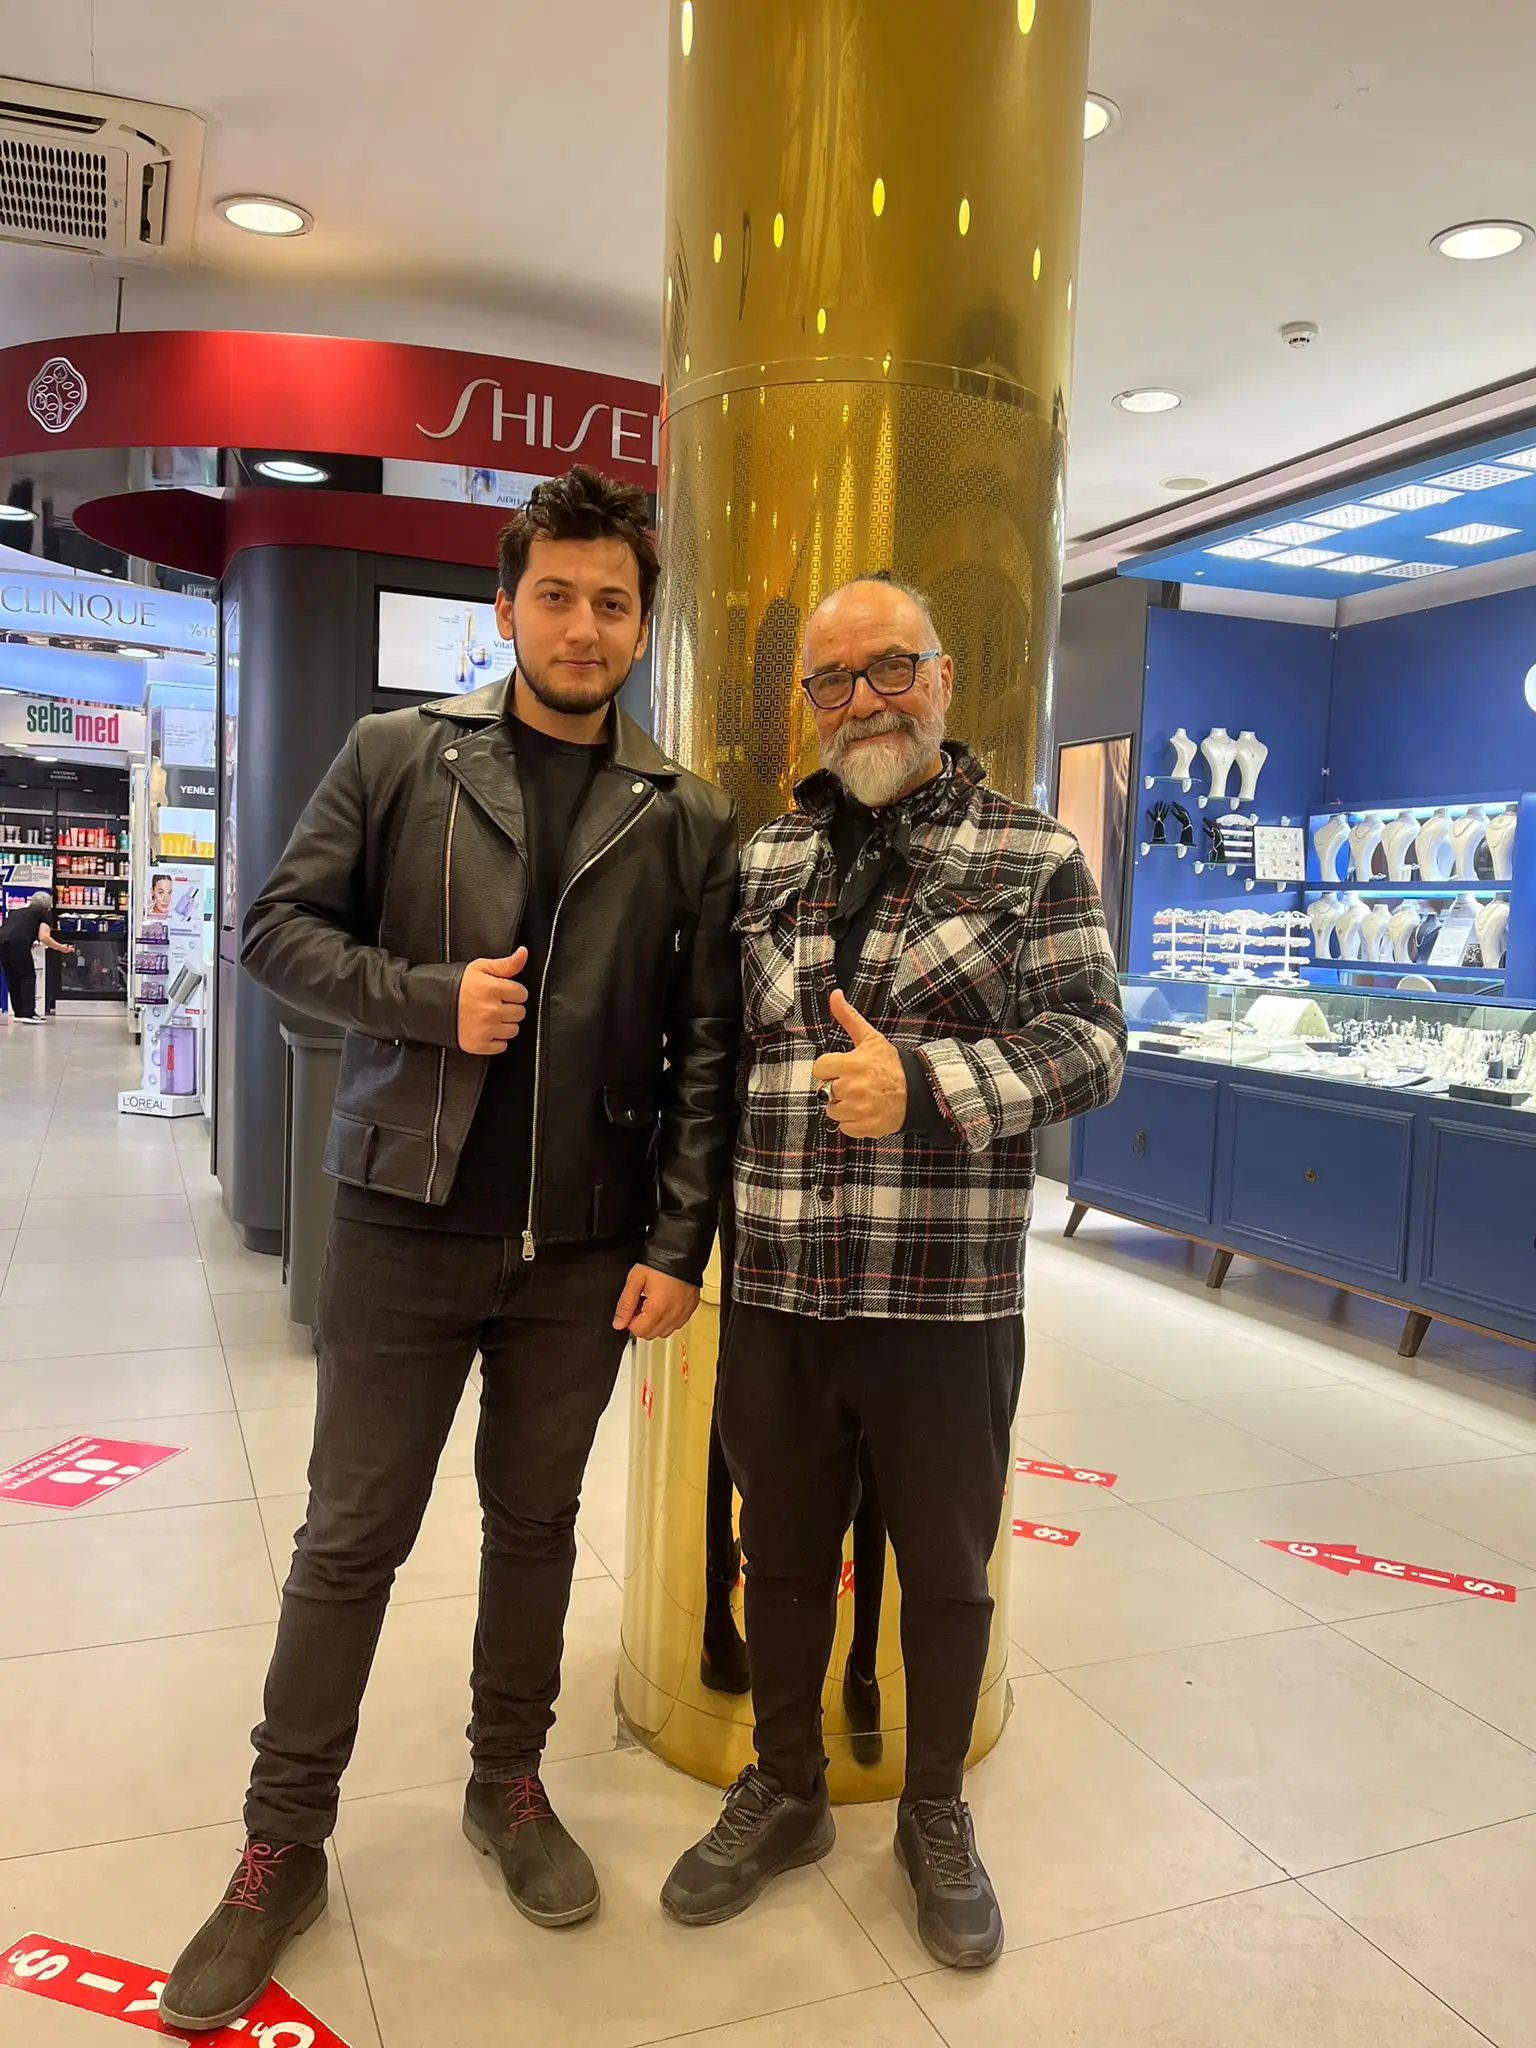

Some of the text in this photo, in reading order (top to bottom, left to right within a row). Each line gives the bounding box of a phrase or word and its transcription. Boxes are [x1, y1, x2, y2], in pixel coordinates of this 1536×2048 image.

[1, 585, 156, 628] CLINIQUE
[26, 702, 120, 745] sebamed
[180, 785, 215, 796] YENİLE
